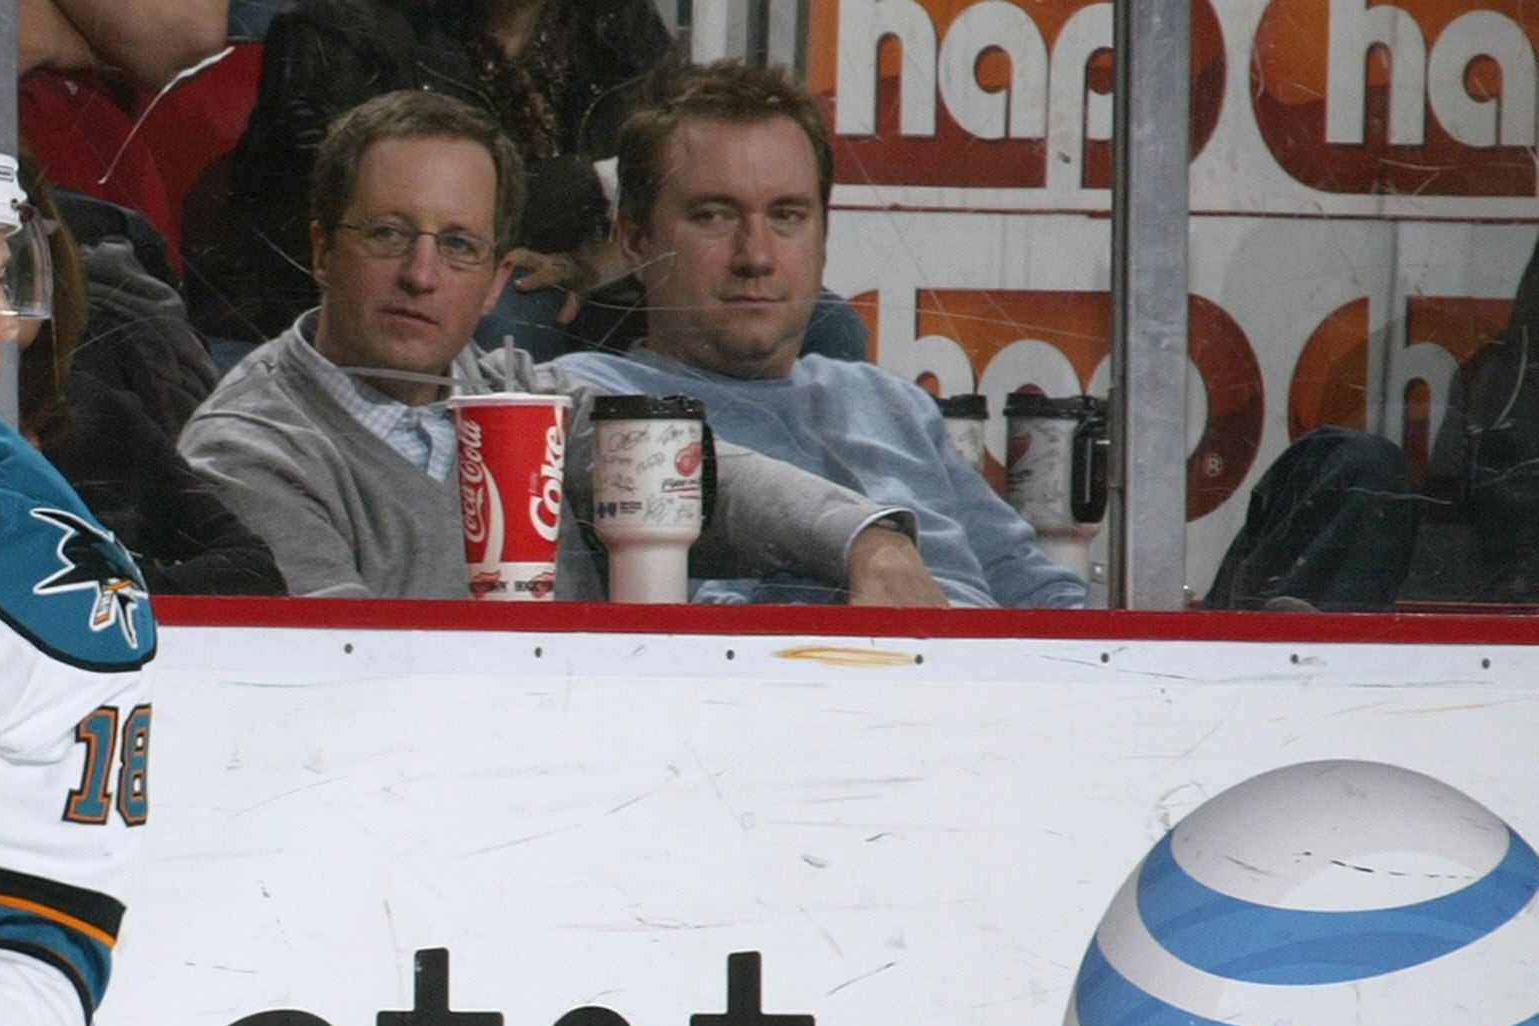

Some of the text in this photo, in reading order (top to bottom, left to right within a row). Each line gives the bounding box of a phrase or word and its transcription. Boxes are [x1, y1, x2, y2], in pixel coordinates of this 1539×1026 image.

[1326, 0, 1539, 147] ha
[530, 424, 565, 542] Coke
[61, 703, 152, 827] 18
